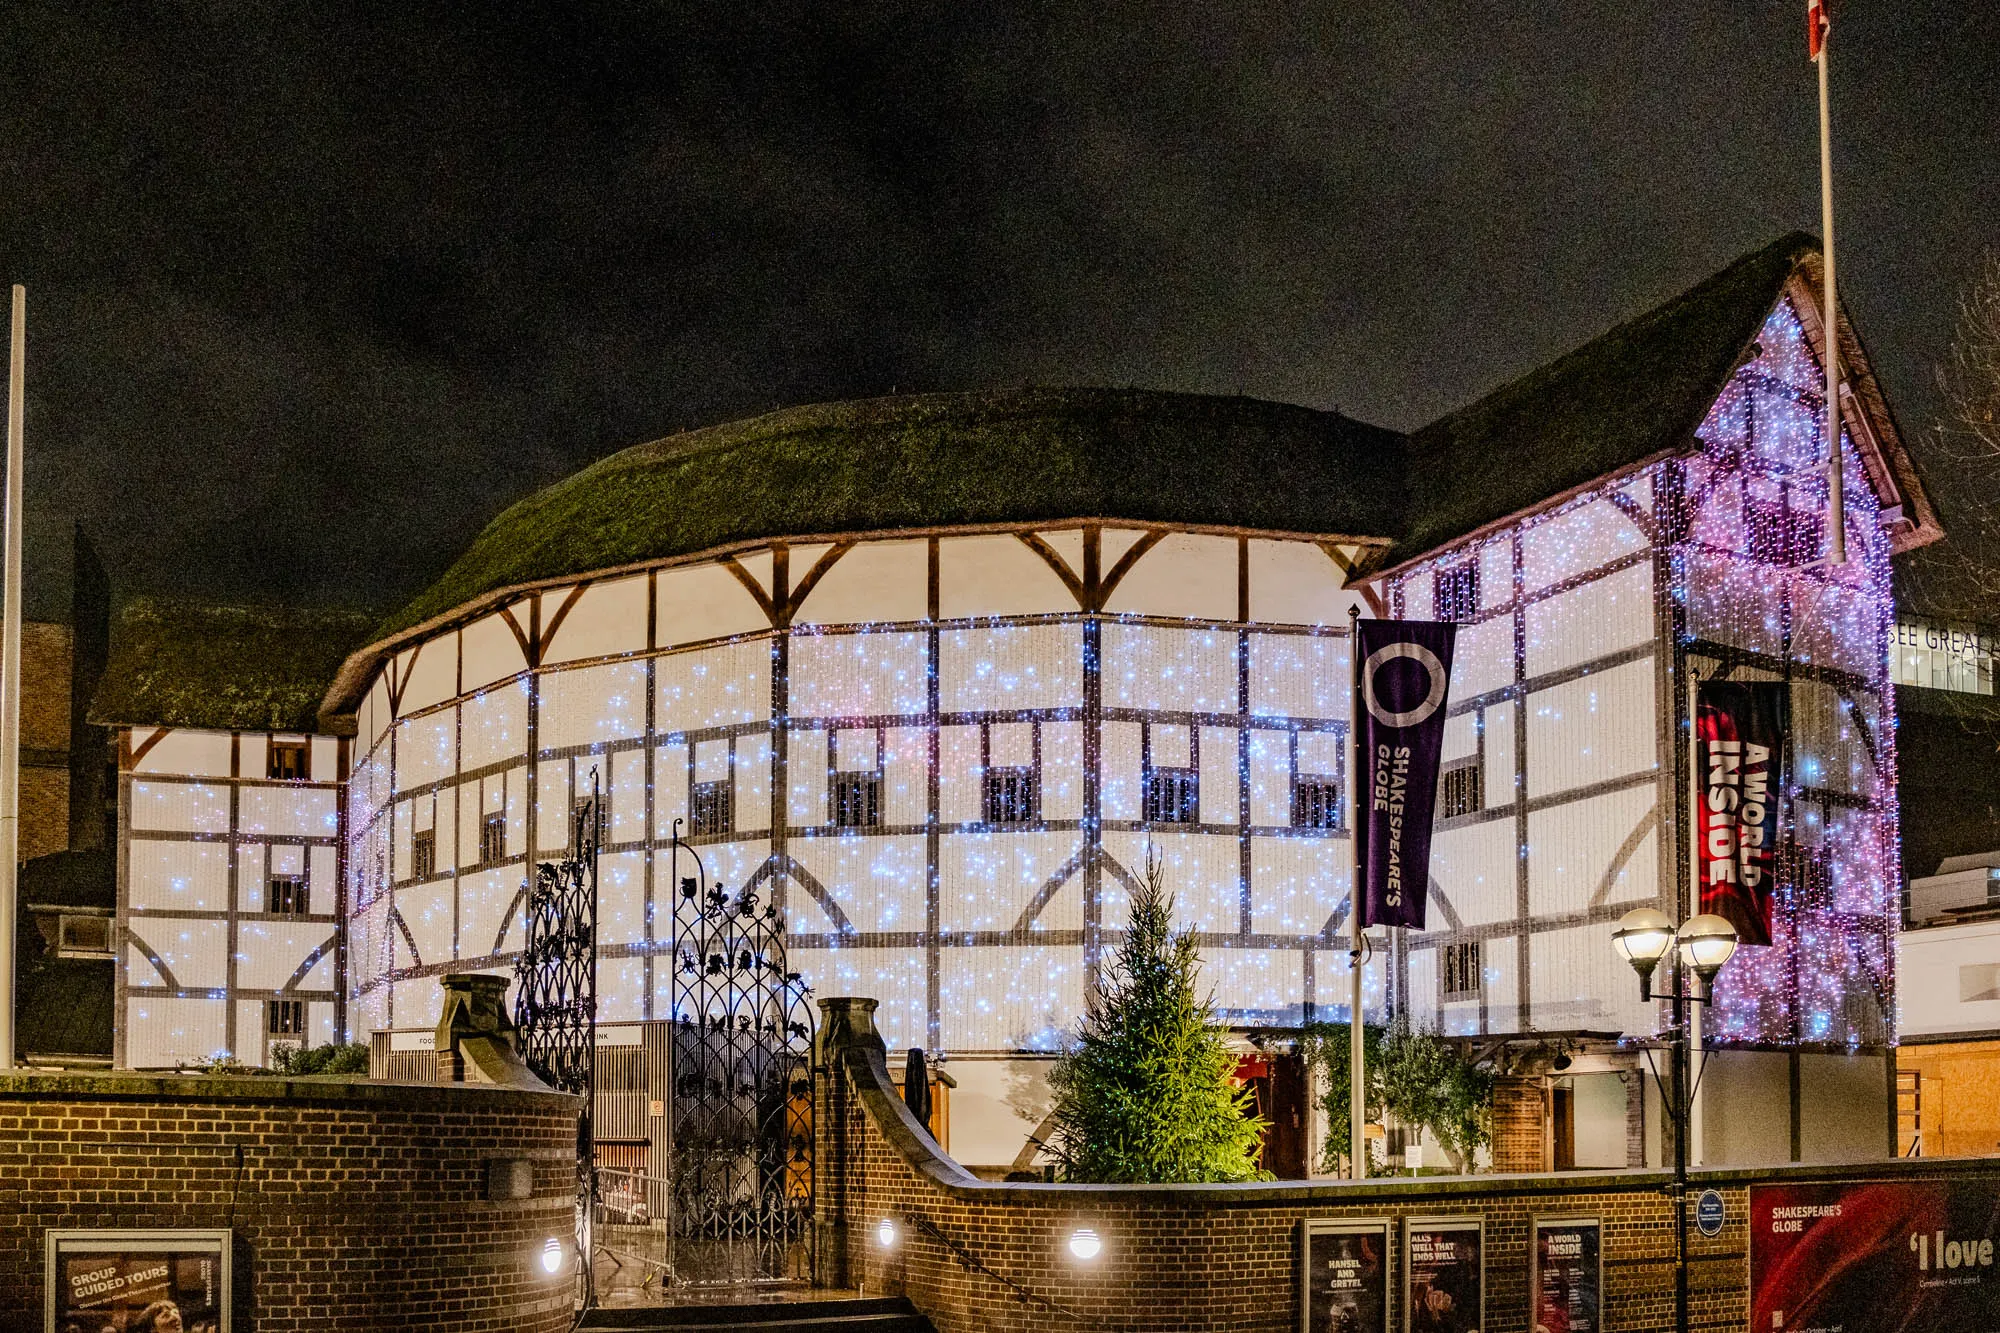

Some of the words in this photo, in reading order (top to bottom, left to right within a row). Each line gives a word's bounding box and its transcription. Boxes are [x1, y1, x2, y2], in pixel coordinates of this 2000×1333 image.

[1926, 627, 1983, 655] GREAT
[1745, 742, 1770, 765] A
[1374, 743, 1391, 811] GLOBE
[1708, 740, 1741, 886] INSIDE
[1386, 746, 1410, 908] SHAKESPEARE'S
[1740, 771, 1768, 887] WORLD
[1772, 1204, 1842, 1219] SHAKESPEARE'S
[1772, 1220, 1803, 1233] GLOBE
[1548, 1234, 1554, 1243] A
[1554, 1233, 1581, 1243] WORLD
[1411, 1243, 1434, 1252] WELL
[1434, 1242, 1454, 1251] THAT
[1548, 1243, 1582, 1255] INSIDE
[1936, 1230, 1993, 1269] love
[1328, 1259, 1362, 1269] HANSEL
[1413, 1252, 1434, 1262] ENDS
[1434, 1251, 1456, 1260] WELL
[71, 1267, 117, 1287] GROUP
[75, 1278, 125, 1298] GUIDED
[126, 1265, 169, 1285] TOURS
[1337, 1270, 1355, 1279] AND
[1331, 1279, 1362, 1289] GRETEL
